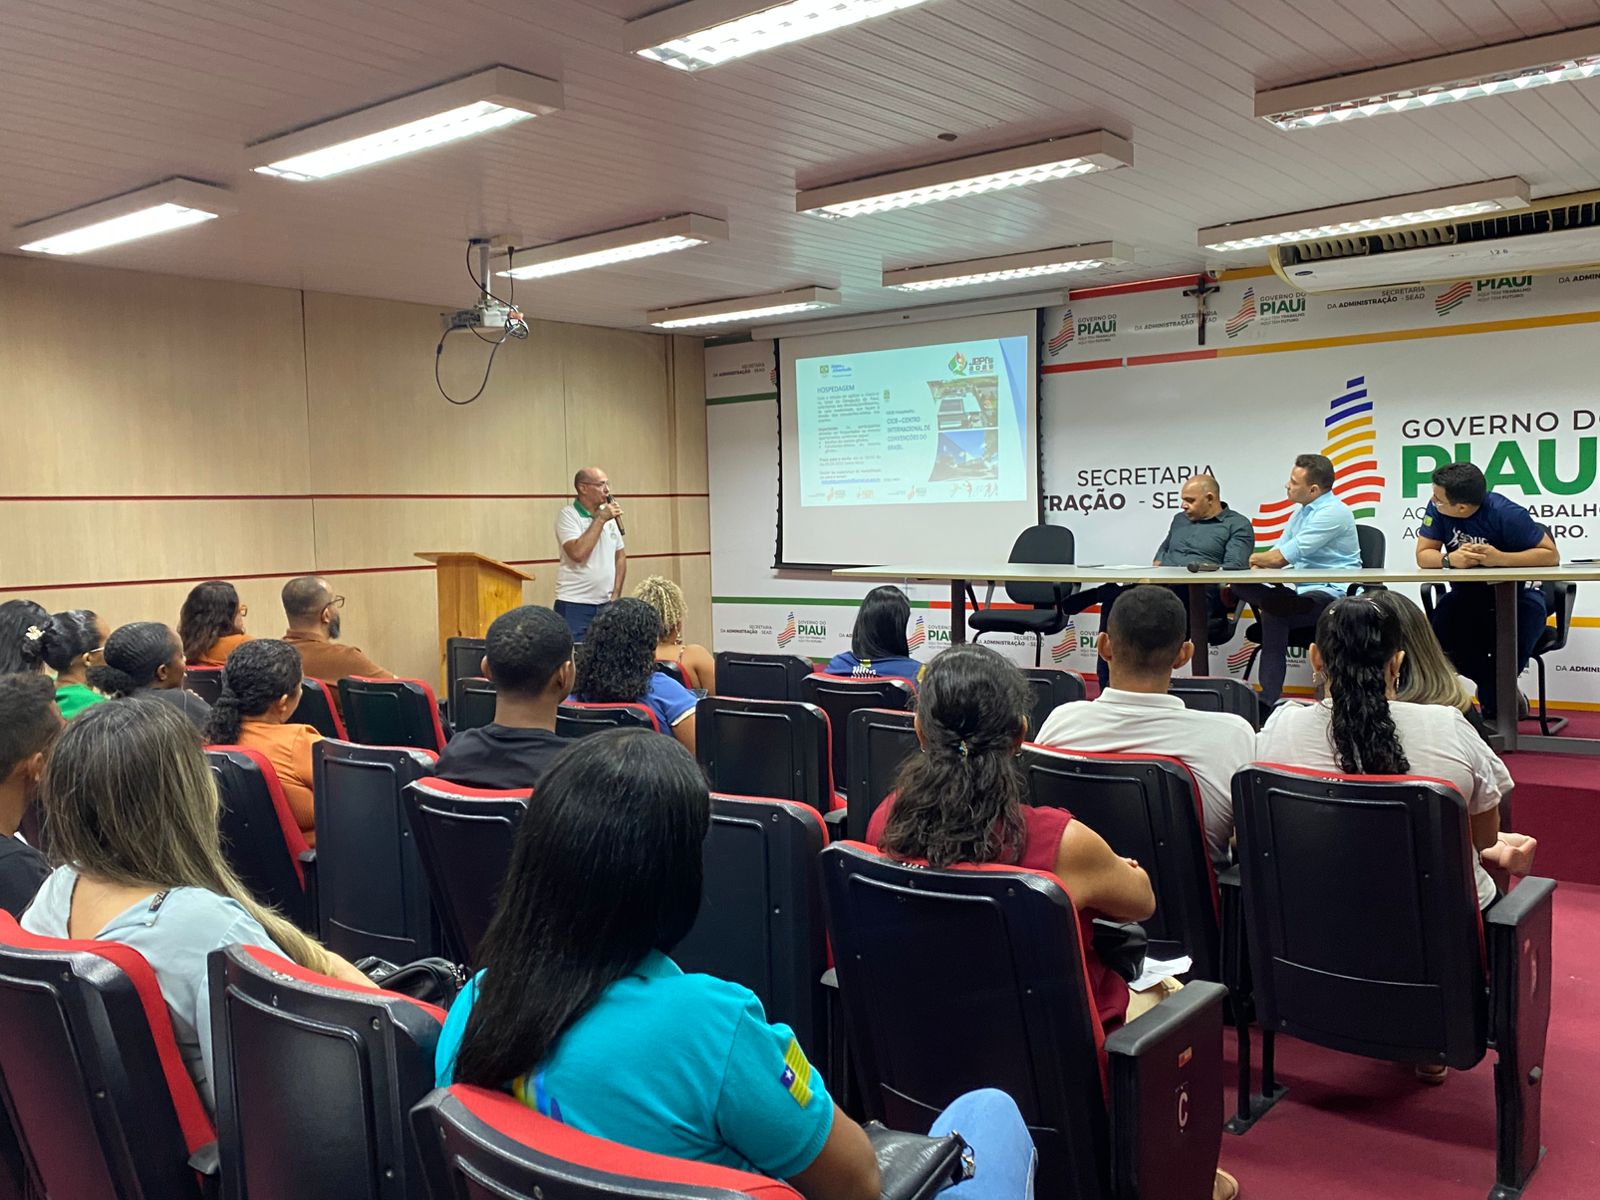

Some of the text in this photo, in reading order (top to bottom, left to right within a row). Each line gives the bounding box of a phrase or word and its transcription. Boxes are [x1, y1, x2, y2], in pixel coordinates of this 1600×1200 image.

[1260, 292, 1294, 302] GOVERNO
[1381, 286, 1426, 297] SECRETARIA
[1338, 296, 1398, 309] ADMINISTRAÇÃO
[1405, 293, 1425, 301] SEAD
[1078, 315, 1106, 323] GOVERNO
[1144, 319, 1195, 330] ADMINISTRAÇÃO
[1402, 409, 1600, 439] GOVERNO D
[1152, 492, 1182, 509] SE
[1179, 1092, 1188, 1127] C
